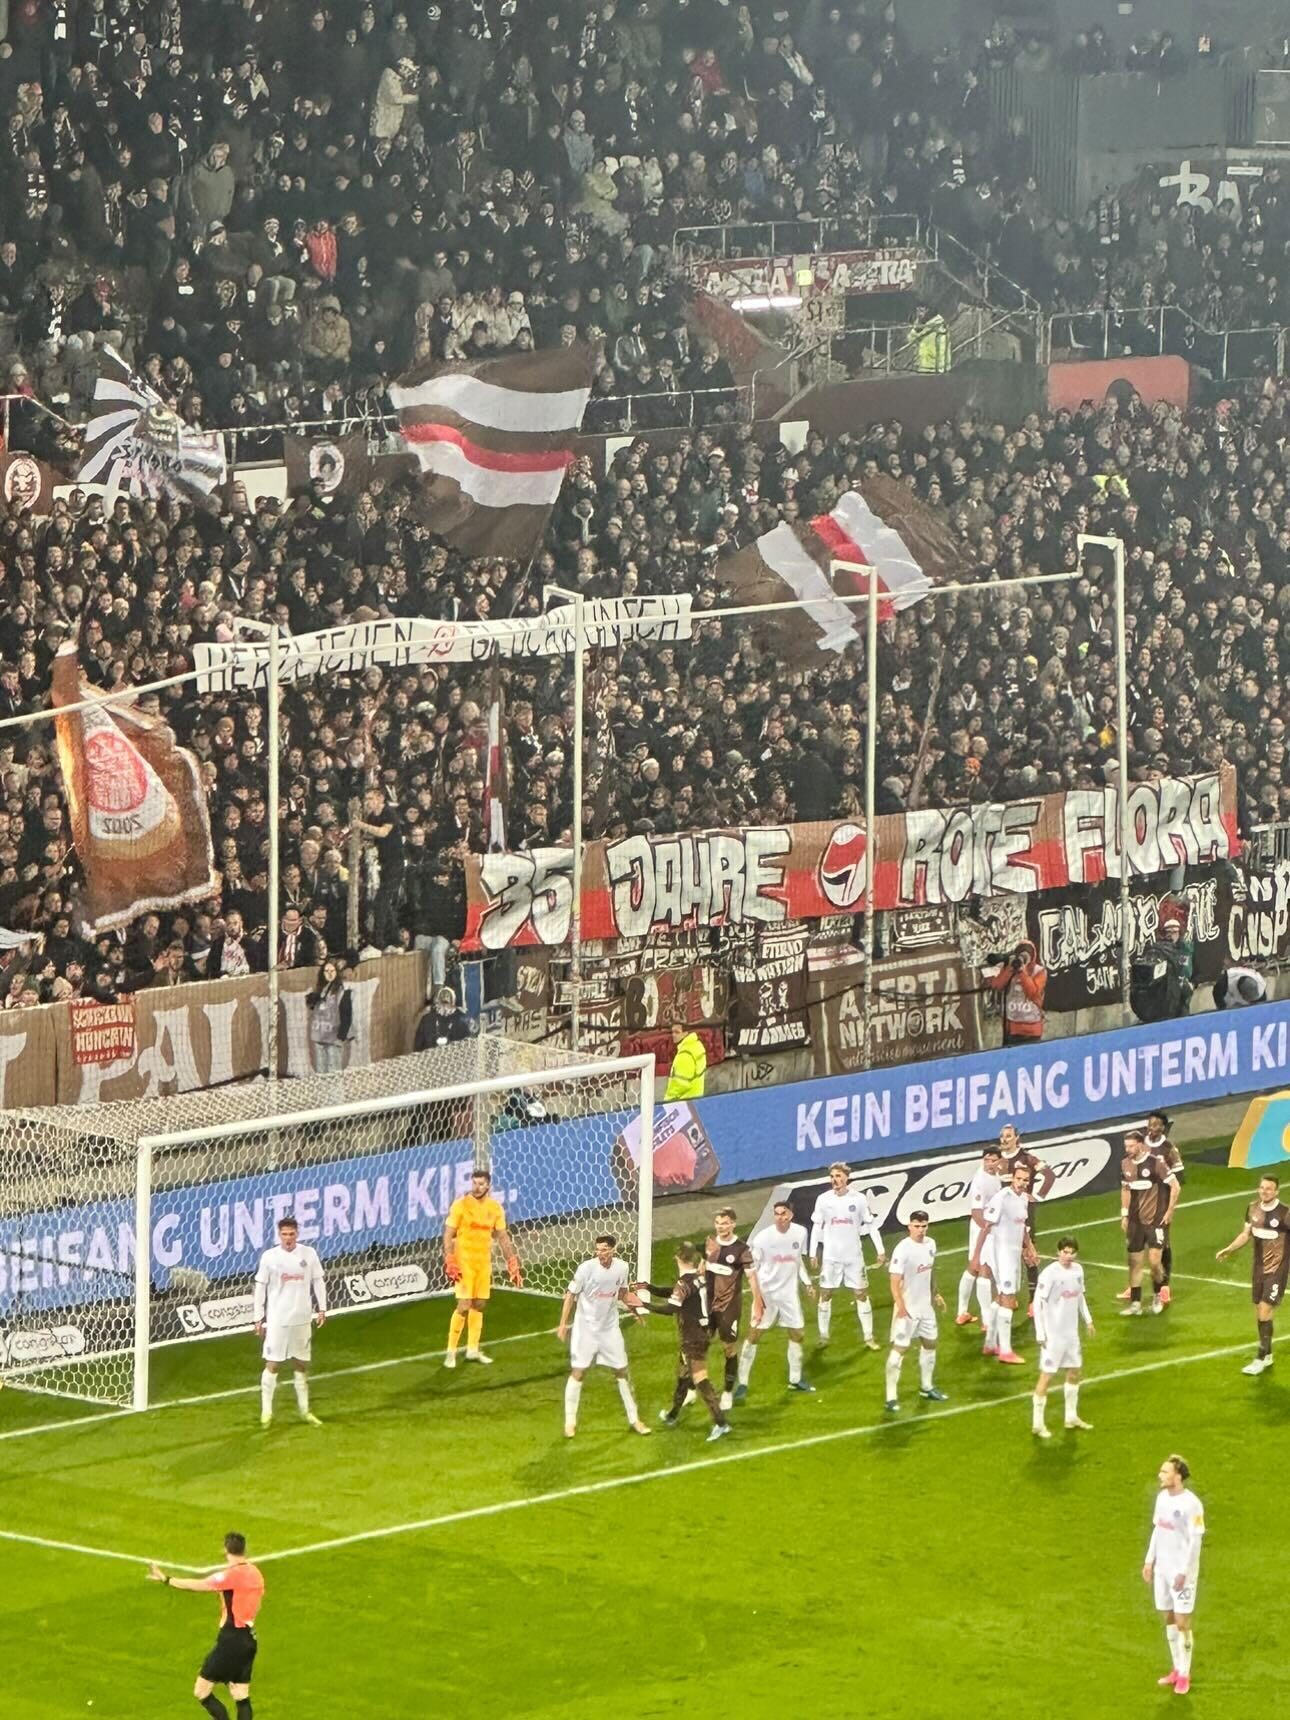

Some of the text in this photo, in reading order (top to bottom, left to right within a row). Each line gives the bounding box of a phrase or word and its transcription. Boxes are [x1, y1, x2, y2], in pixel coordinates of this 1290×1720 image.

[479, 846, 575, 949] 35
[606, 828, 791, 937] JAHRE
[900, 803, 1044, 903] ROTE
[1064, 774, 1229, 883] FLORA
[797, 1091, 890, 1151] KEIN
[904, 1060, 1069, 1134] BEIFANG
[1083, 1031, 1238, 1101] UNTERM
[200, 1176, 390, 1258] UNTERM
